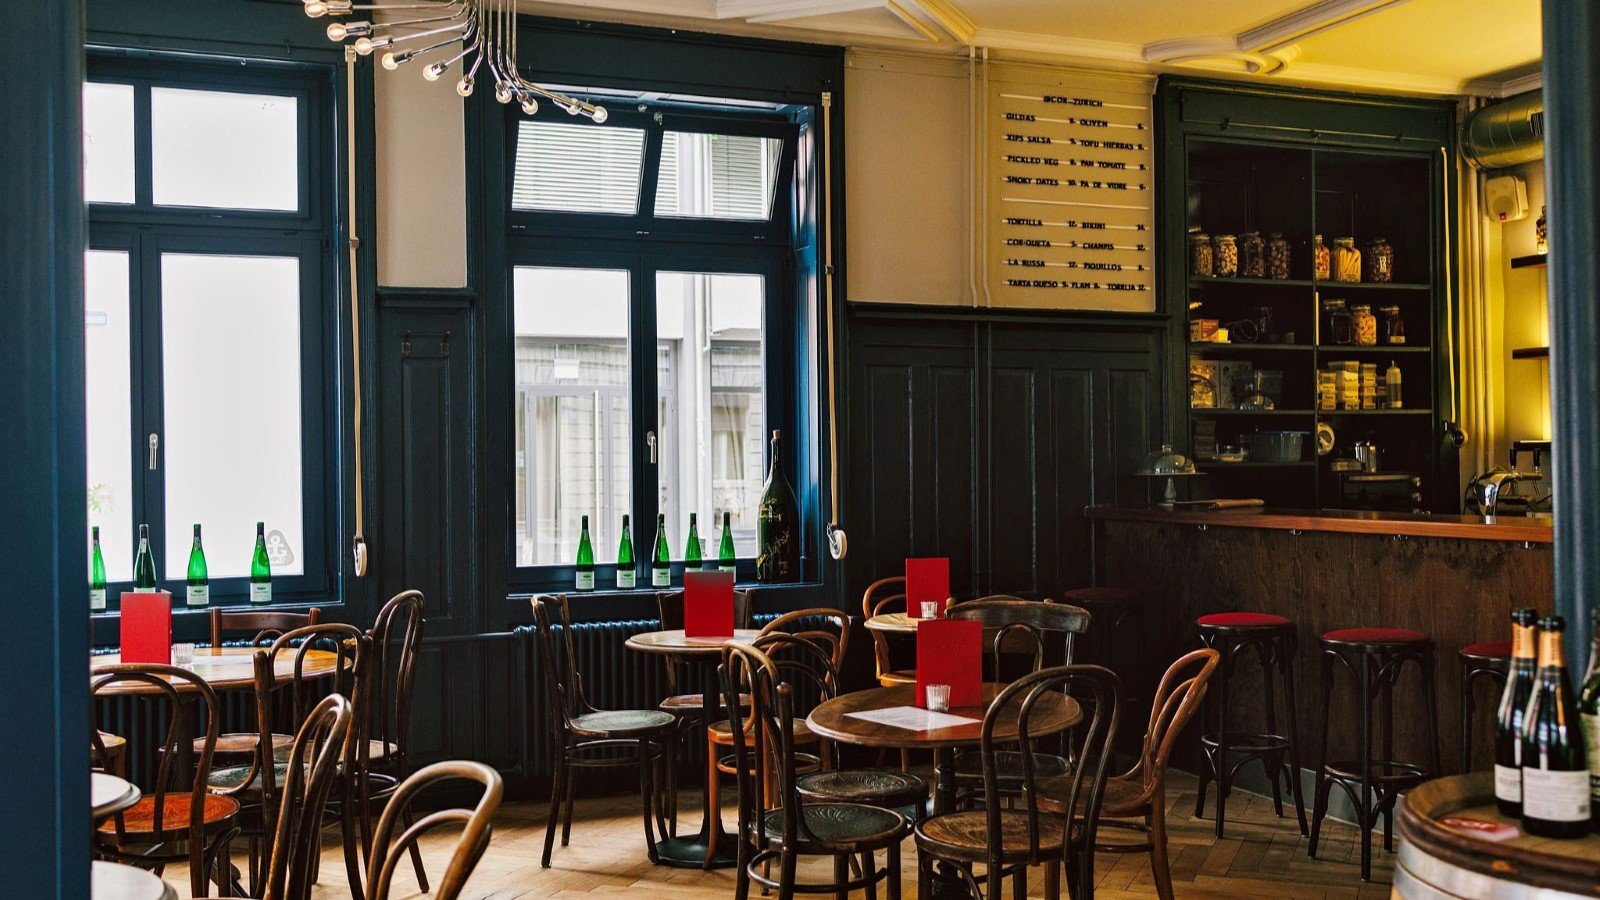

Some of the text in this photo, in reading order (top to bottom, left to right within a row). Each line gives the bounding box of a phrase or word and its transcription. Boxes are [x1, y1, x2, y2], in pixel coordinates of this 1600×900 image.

[1006, 113, 1035, 122] GILDAS
[1080, 119, 1107, 127] OLIVEN
[1006, 134, 1023, 142] XIPS
[1027, 136, 1051, 144] SALSA
[1080, 140, 1099, 148] TOFU
[1103, 141, 1134, 150] HIERBAS
[1007, 155, 1040, 164] PICKLED
[1043, 158, 1058, 166] VEG
[1097, 161, 1126, 169] TOMATE
[1007, 176, 1032, 184] SMOKY
[1036, 178, 1058, 186] DATES
[1007, 218, 1043, 226] TORTILLA
[1084, 262, 1122, 271] PIQUILLOS
[1008, 279, 1031, 287] TARTA
[1032, 280, 1058, 288] QUESO
